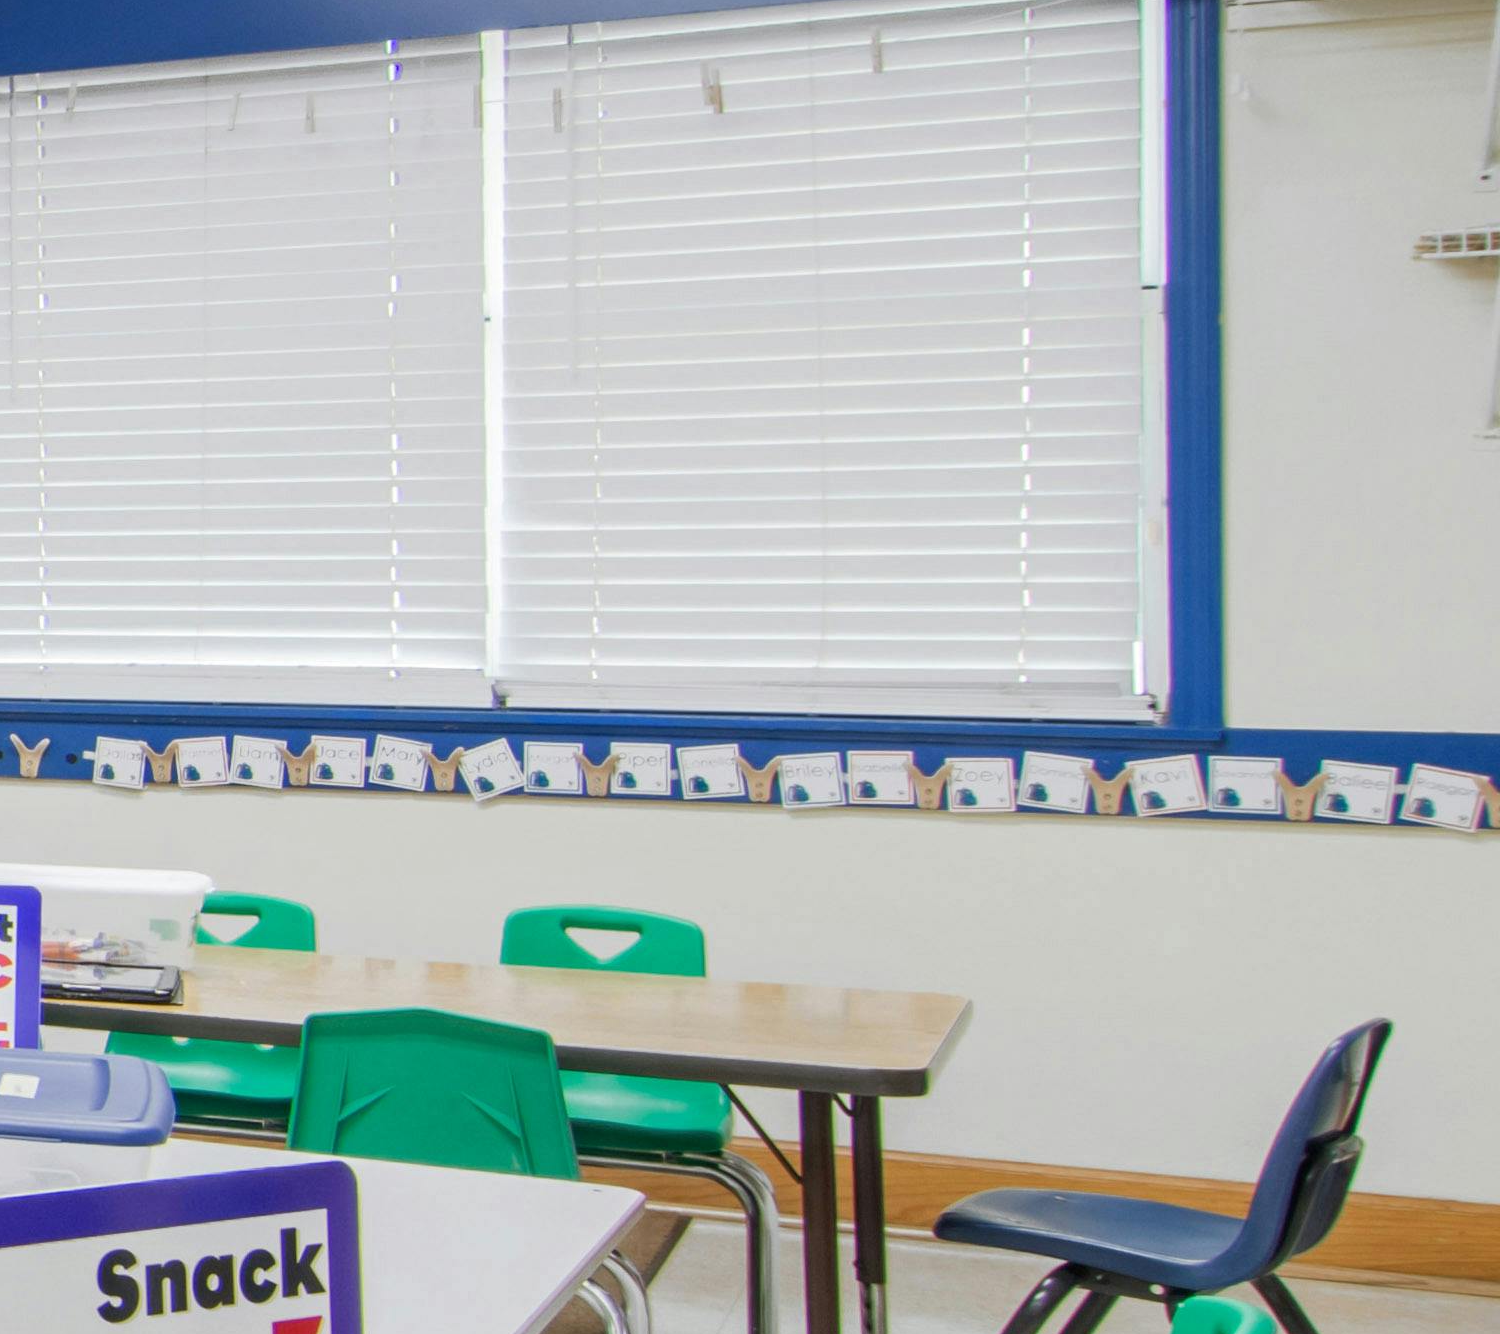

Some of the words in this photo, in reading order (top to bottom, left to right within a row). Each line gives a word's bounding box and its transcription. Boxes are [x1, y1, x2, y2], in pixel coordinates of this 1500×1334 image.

[240, 748, 278, 760] Liam
[317, 746, 359, 760] Jace
[382, 746, 422, 764] Mary
[619, 752, 666, 768] Piper
[467, 752, 509, 773] Lydia
[954, 768, 1003, 784] Zoey
[98, 1228, 325, 1322] Snack
